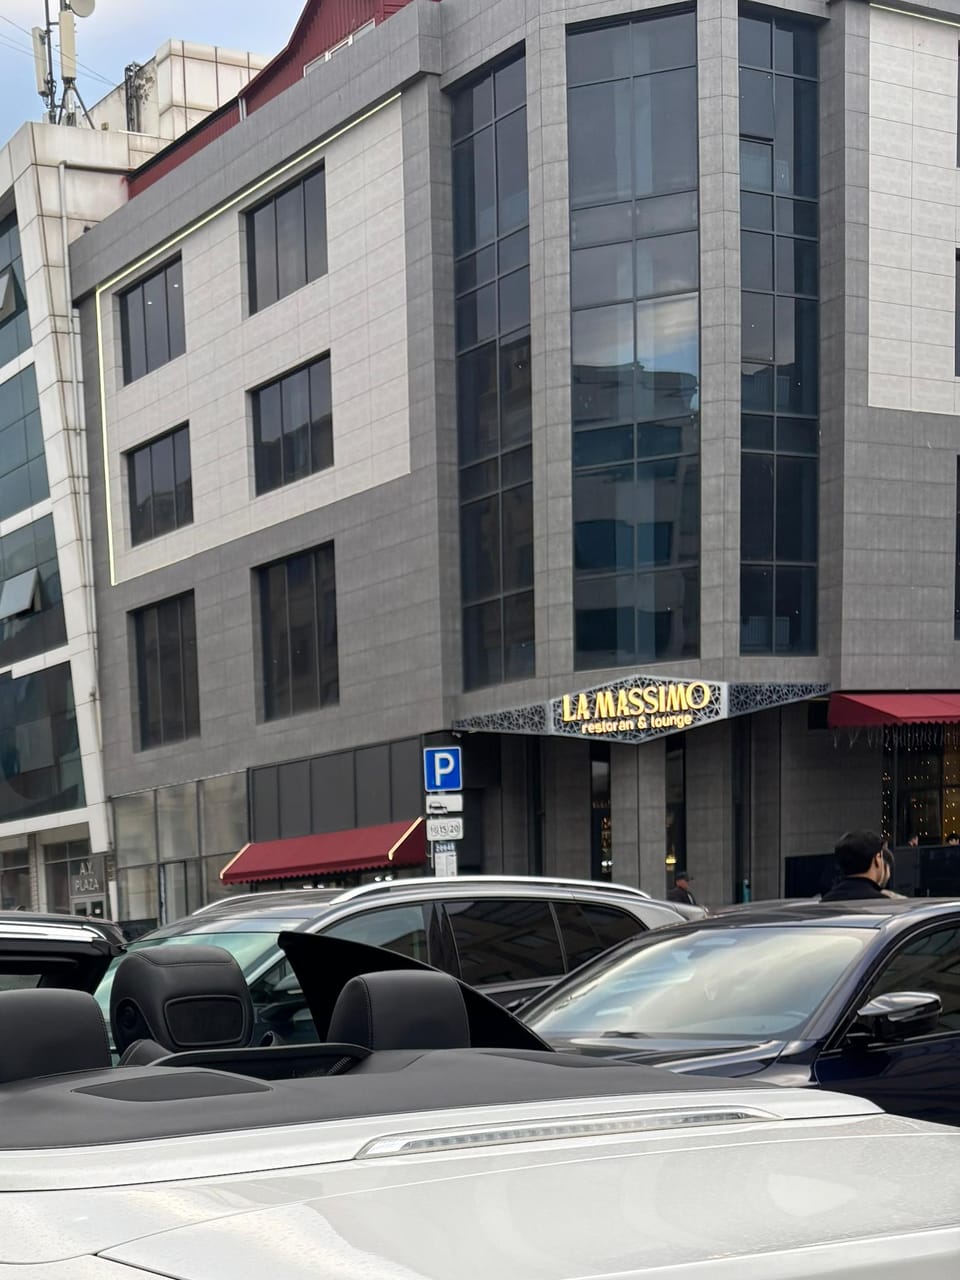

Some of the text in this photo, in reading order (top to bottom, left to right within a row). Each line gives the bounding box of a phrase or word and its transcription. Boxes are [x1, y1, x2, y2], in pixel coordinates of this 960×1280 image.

[562, 681, 711, 721] LA MASSIMO
[582, 713, 692, 733] restoran & lounge
[435, 753, 454, 786] P
[75, 878, 99, 891] PLAZA
